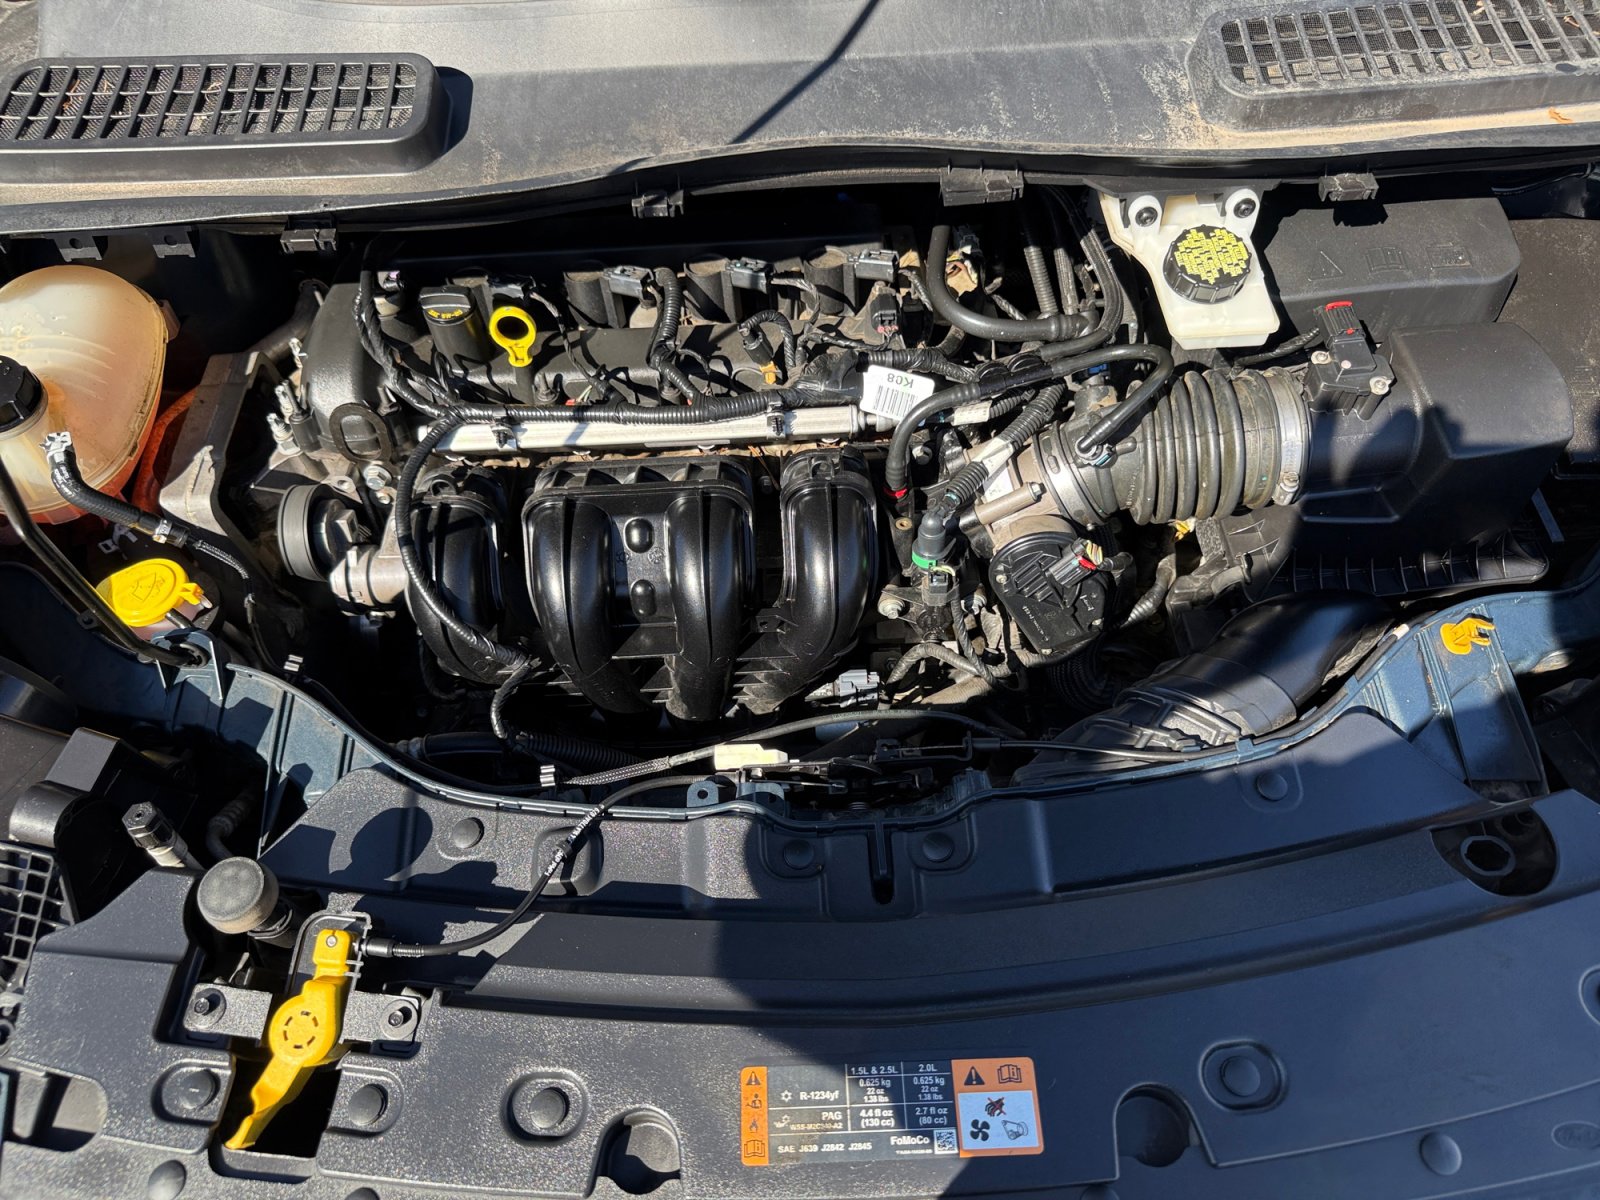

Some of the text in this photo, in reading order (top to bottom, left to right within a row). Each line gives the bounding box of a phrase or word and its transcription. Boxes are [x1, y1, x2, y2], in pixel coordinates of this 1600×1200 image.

[851, 1065, 898, 1075] 1.5L & 2.5L
[919, 1064, 938, 1072] 2.0L
[859, 1078, 891, 1088] 0.625 kg
[913, 1076, 945, 1086] 0.625 kg
[800, 1090, 840, 1101] R-1234yf
[822, 1112, 843, 1121] PAG
[860, 1109, 873, 1117] 4.4
[860, 1117, 895, 1128] (130 cc)
[918, 1116, 947, 1125] (80 cc)
[890, 1135, 930, 1145] FoMoCo
[777, 1145, 796, 1153] SAE
